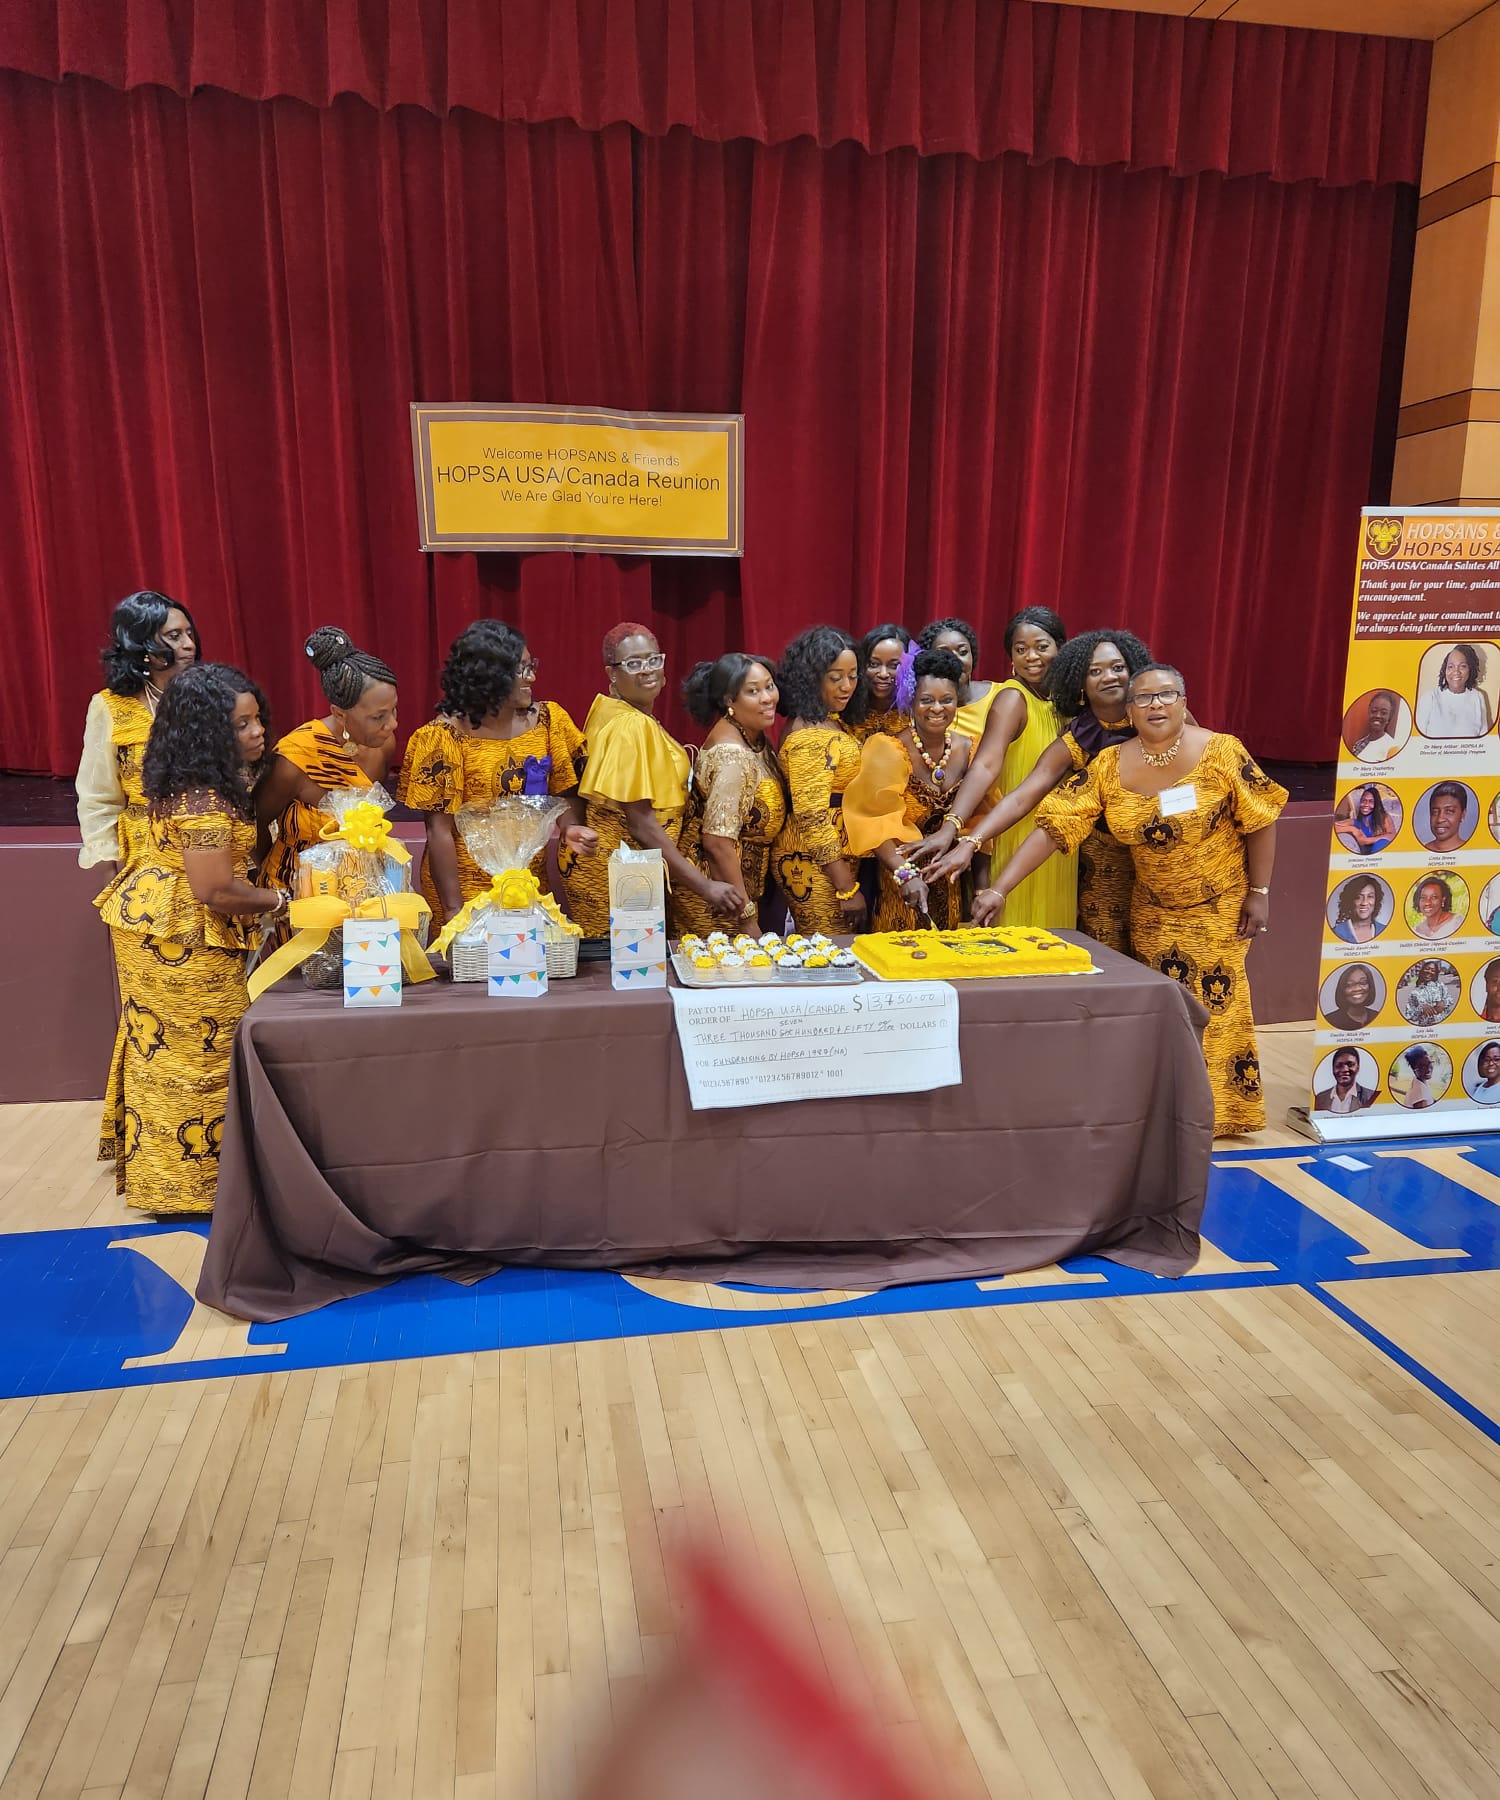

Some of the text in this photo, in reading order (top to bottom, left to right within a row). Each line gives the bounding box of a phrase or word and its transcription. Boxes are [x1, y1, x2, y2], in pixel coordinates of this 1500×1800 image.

[483, 447, 681, 467] Welcome HOPSANS & Friends
[437, 465, 720, 491] HOPSA USA/Canada Reunion
[501, 489, 662, 507] We Are Glad You're Here!
[1406, 522, 1489, 540] HOPSANS
[1403, 541, 1463, 557] HOPSA
[1361, 560, 1499, 571] HOPSA USA/Canada Salutes All
[1360, 579, 1388, 590] Thank
[1390, 581, 1407, 591] you
[1409, 579, 1421, 591] for
[1423, 581, 1444, 591] your
[1446, 580, 1468, 590] time,
[1358, 593, 1427, 604] encouragement.
[1357, 611, 1370, 621] We
[1372, 610, 1417, 622] appreciate
[1419, 612, 1439, 622] your
[1440, 610, 1493, 620] commitment
[1355, 622, 1369, 635] for
[1369, 622, 1399, 634] always
[1399, 622, 1423, 634] being
[1424, 622, 1447, 633] there
[1447, 622, 1471, 632] when
[1471, 625, 1483, 633] we
[688, 1004, 736, 1016] PAY TO THE
[741, 1007, 775, 1021] HOPSA
[688, 1015, 731, 1026] ORDER OF
[780, 1018, 804, 1027] SEVEN
[900, 1019, 937, 1031] DOLLARS
[695, 1032, 727, 1045] THREE
[729, 1028, 778, 1041] THOUSAND
[844, 1021, 875, 1034] FIFTY
[826, 1068, 844, 1079] 1001
